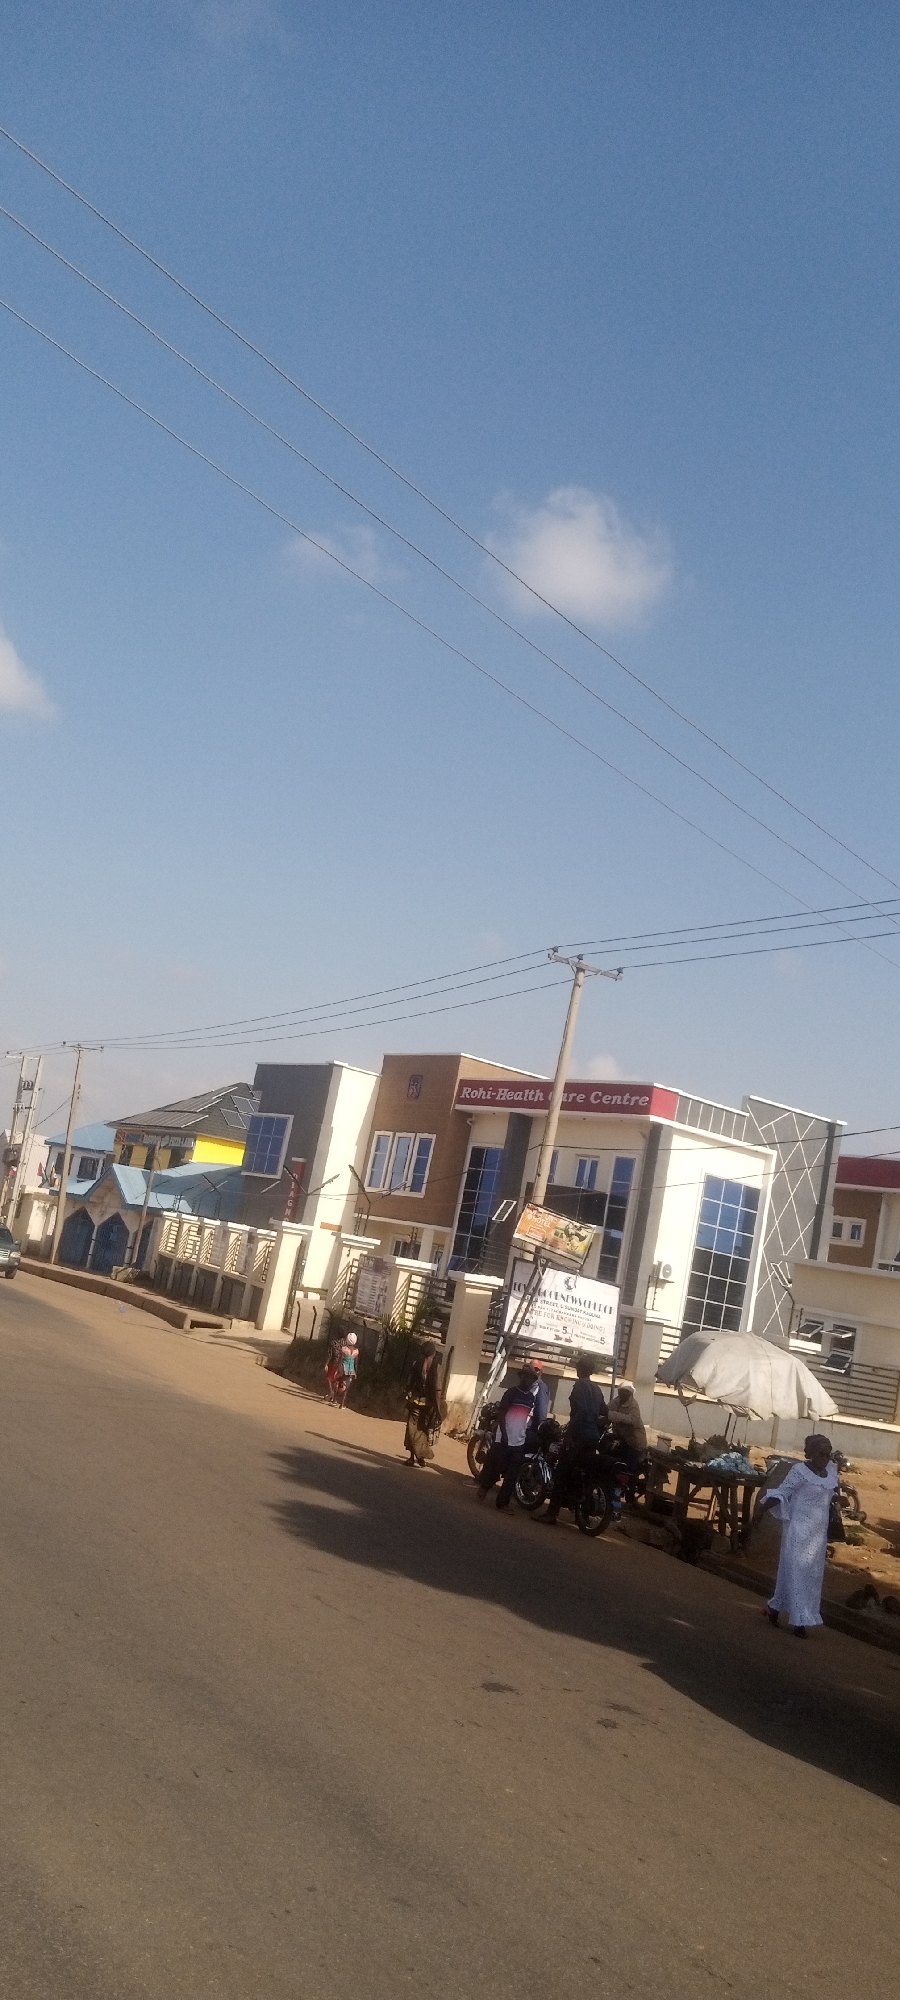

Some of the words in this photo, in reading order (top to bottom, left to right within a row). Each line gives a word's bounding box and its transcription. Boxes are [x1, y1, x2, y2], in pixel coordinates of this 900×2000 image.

[460, 1087, 544, 1101] Rohi-Health
[590, 1091, 650, 1106] Centre
[532, 1217, 550, 1228] HOTEL
